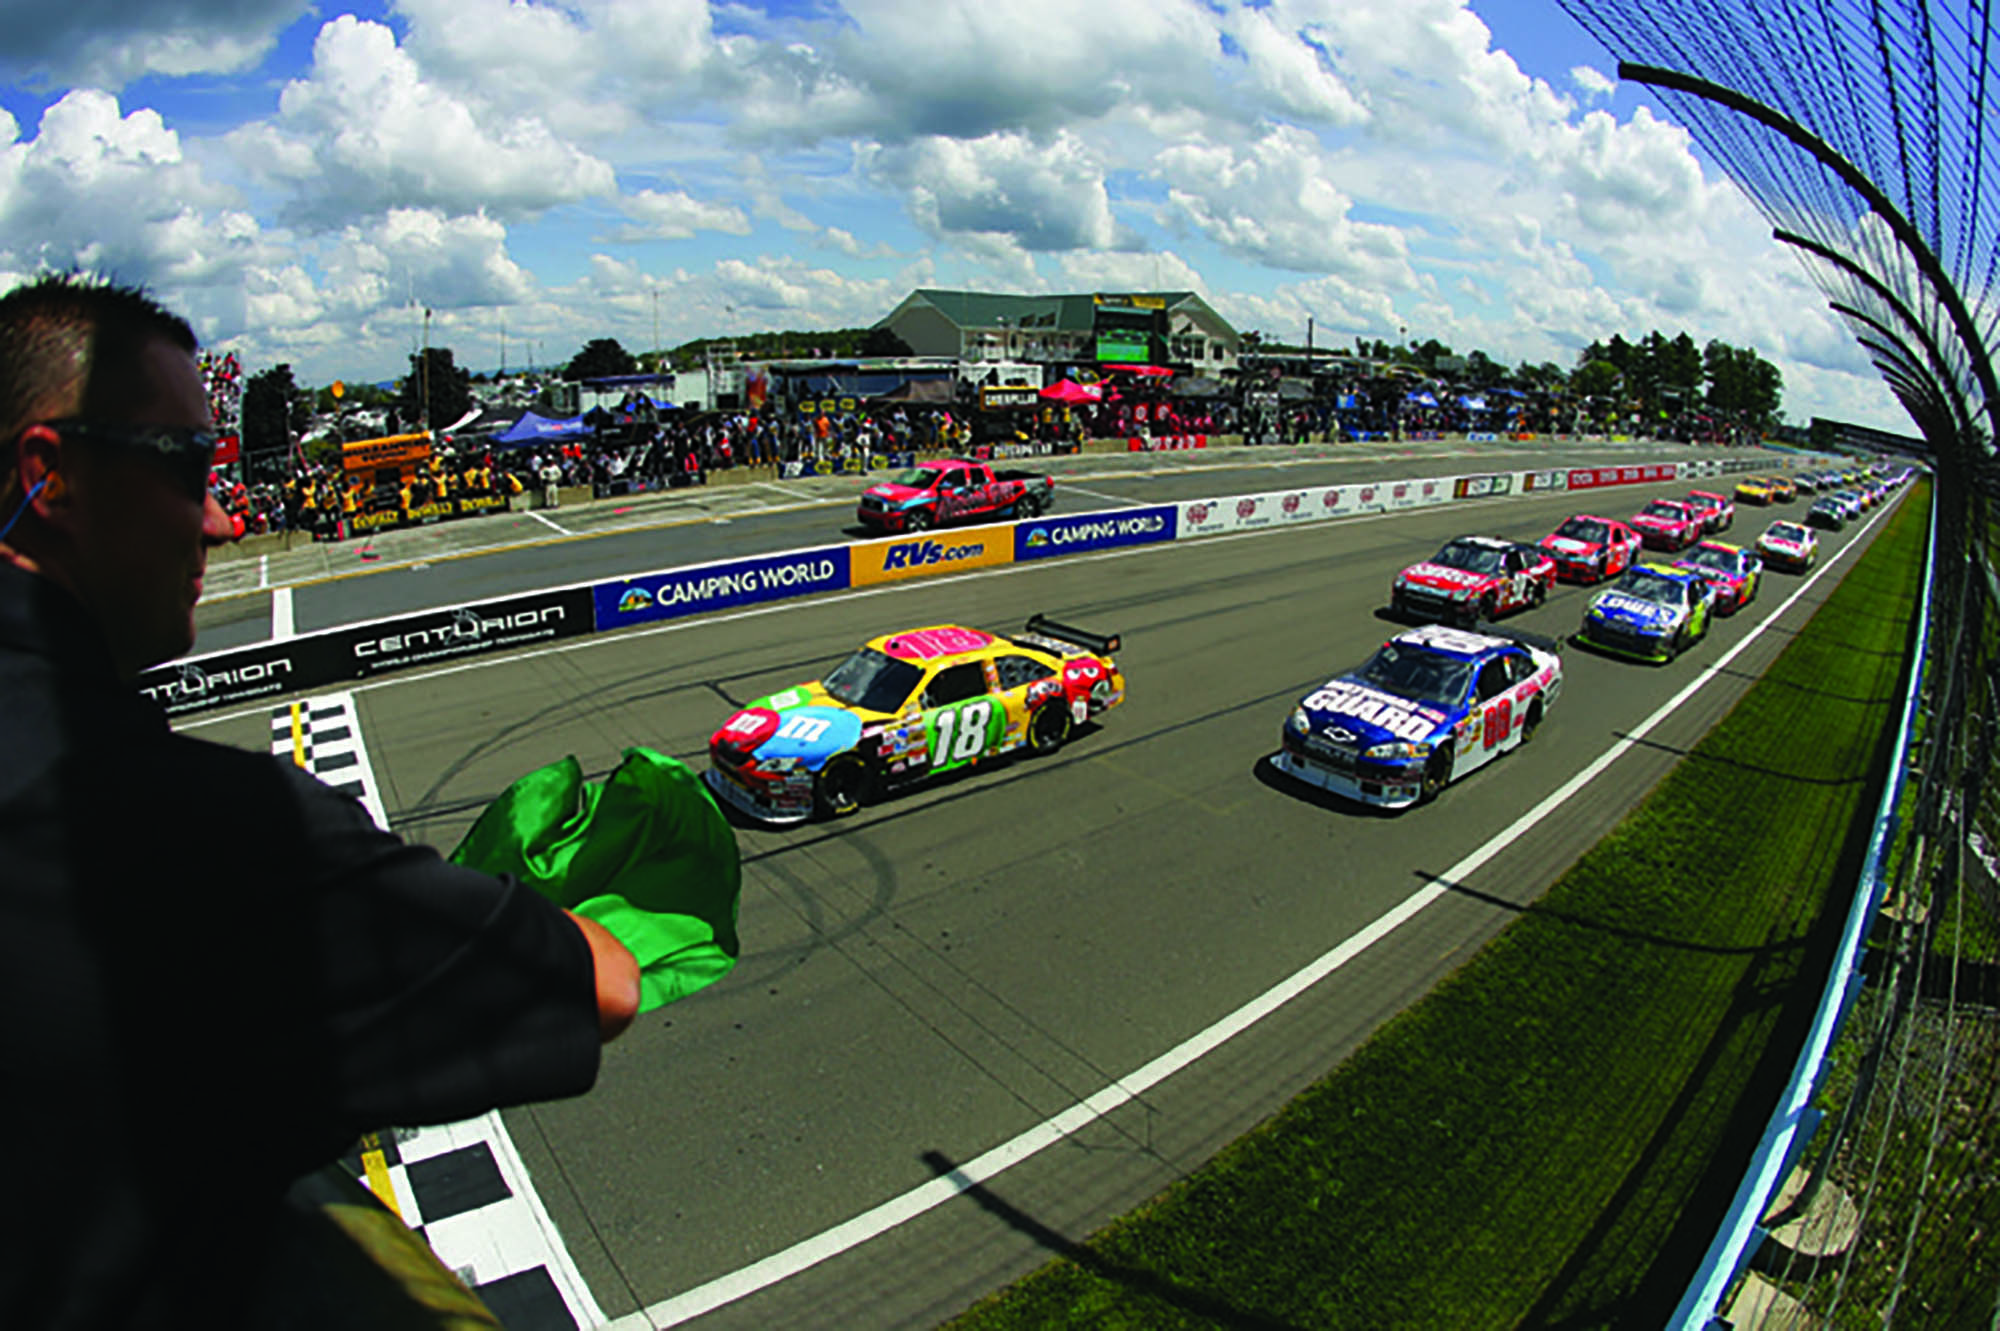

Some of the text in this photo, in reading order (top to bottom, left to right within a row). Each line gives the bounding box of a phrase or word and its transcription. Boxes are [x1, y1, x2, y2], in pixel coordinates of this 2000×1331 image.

[1051, 519, 1115, 545] CAMPING
[1117, 515, 1165, 534] WORLD
[882, 540, 984, 571] RVs.com
[657, 560, 834, 606] CAMPING WORLD
[354, 605, 565, 657] CENTURION
[139, 658, 292, 700] NTURION
[933, 701, 991, 767] 18
[1303, 688, 1436, 742] GUARD
